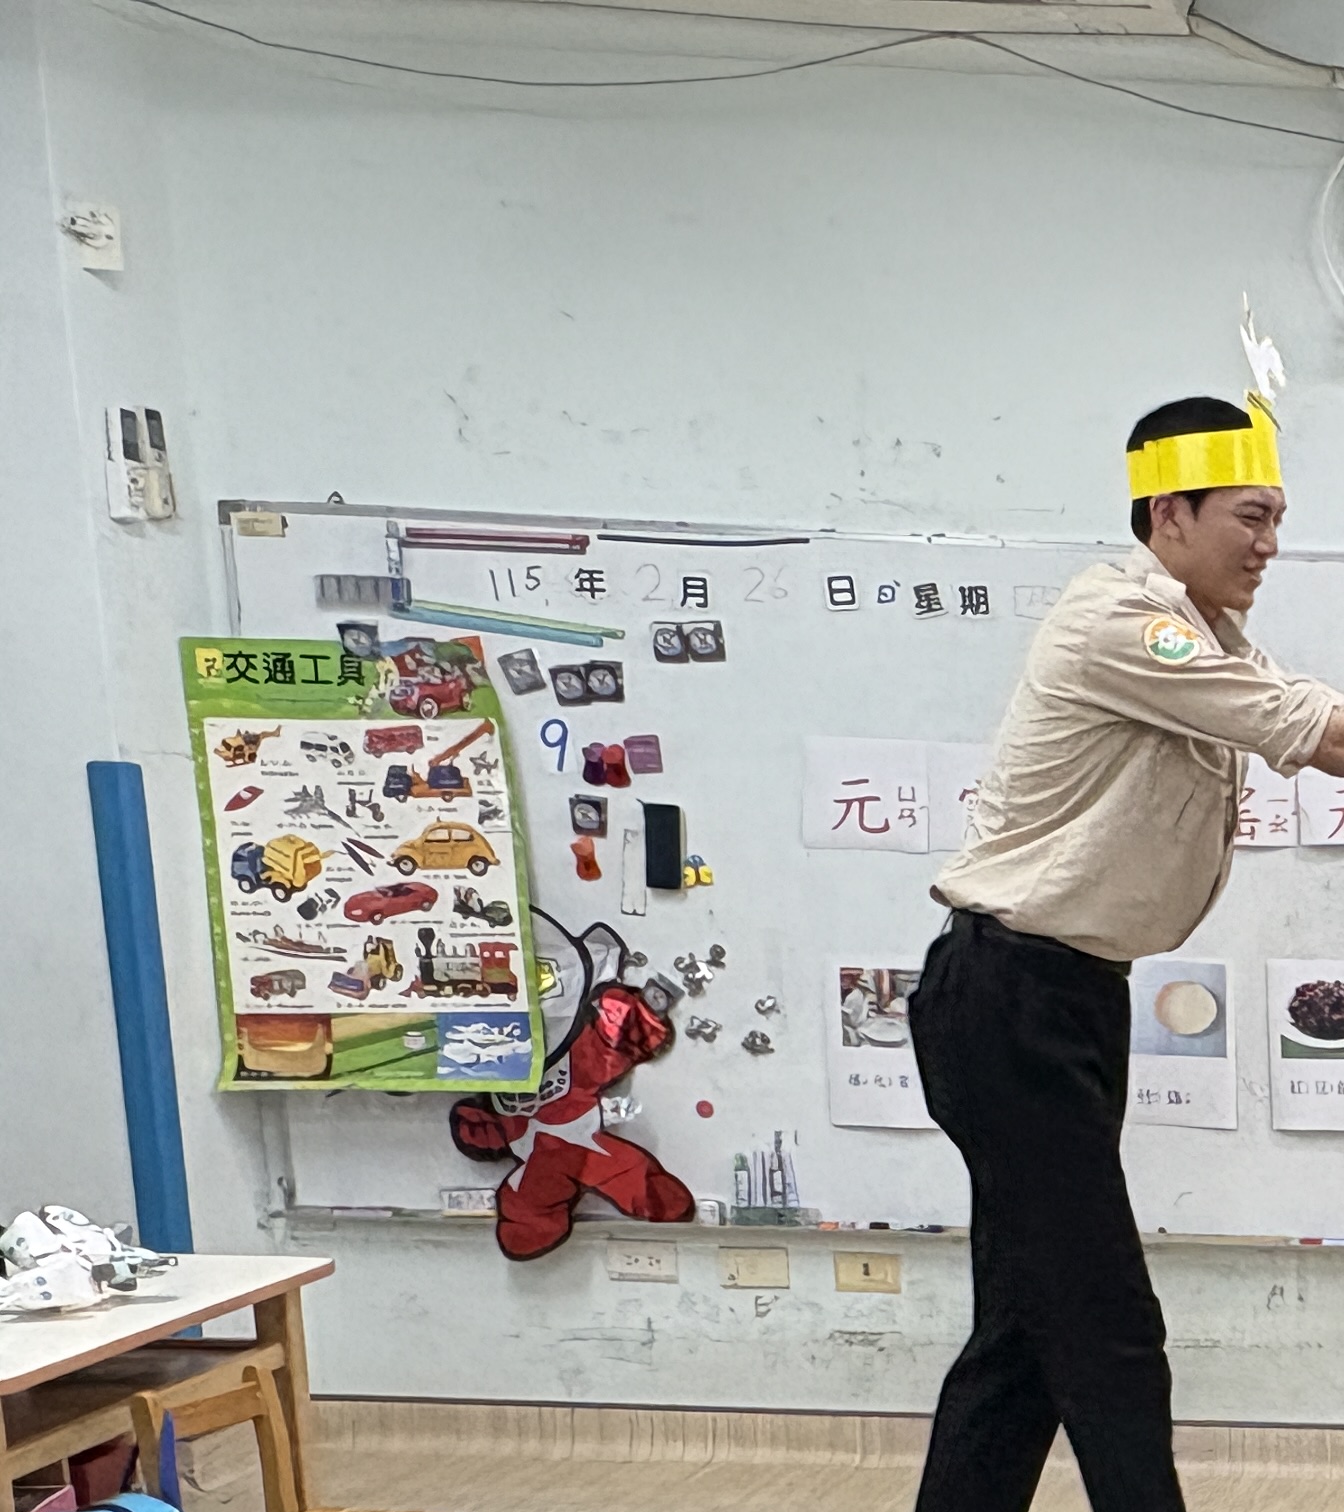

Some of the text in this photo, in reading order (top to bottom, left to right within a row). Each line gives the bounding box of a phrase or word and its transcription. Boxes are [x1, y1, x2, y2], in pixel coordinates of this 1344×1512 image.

[489, 565, 542, 601] 115
[574, 567, 607, 599] 年
[636, 563, 666, 601] 2
[680, 575, 709, 608] 月
[827, 575, 857, 606] 日
[913, 583, 990, 615] 星期
[223, 651, 365, 686] 交通工具
[540, 719, 569, 772] 9
[832, 779, 891, 833] 元
